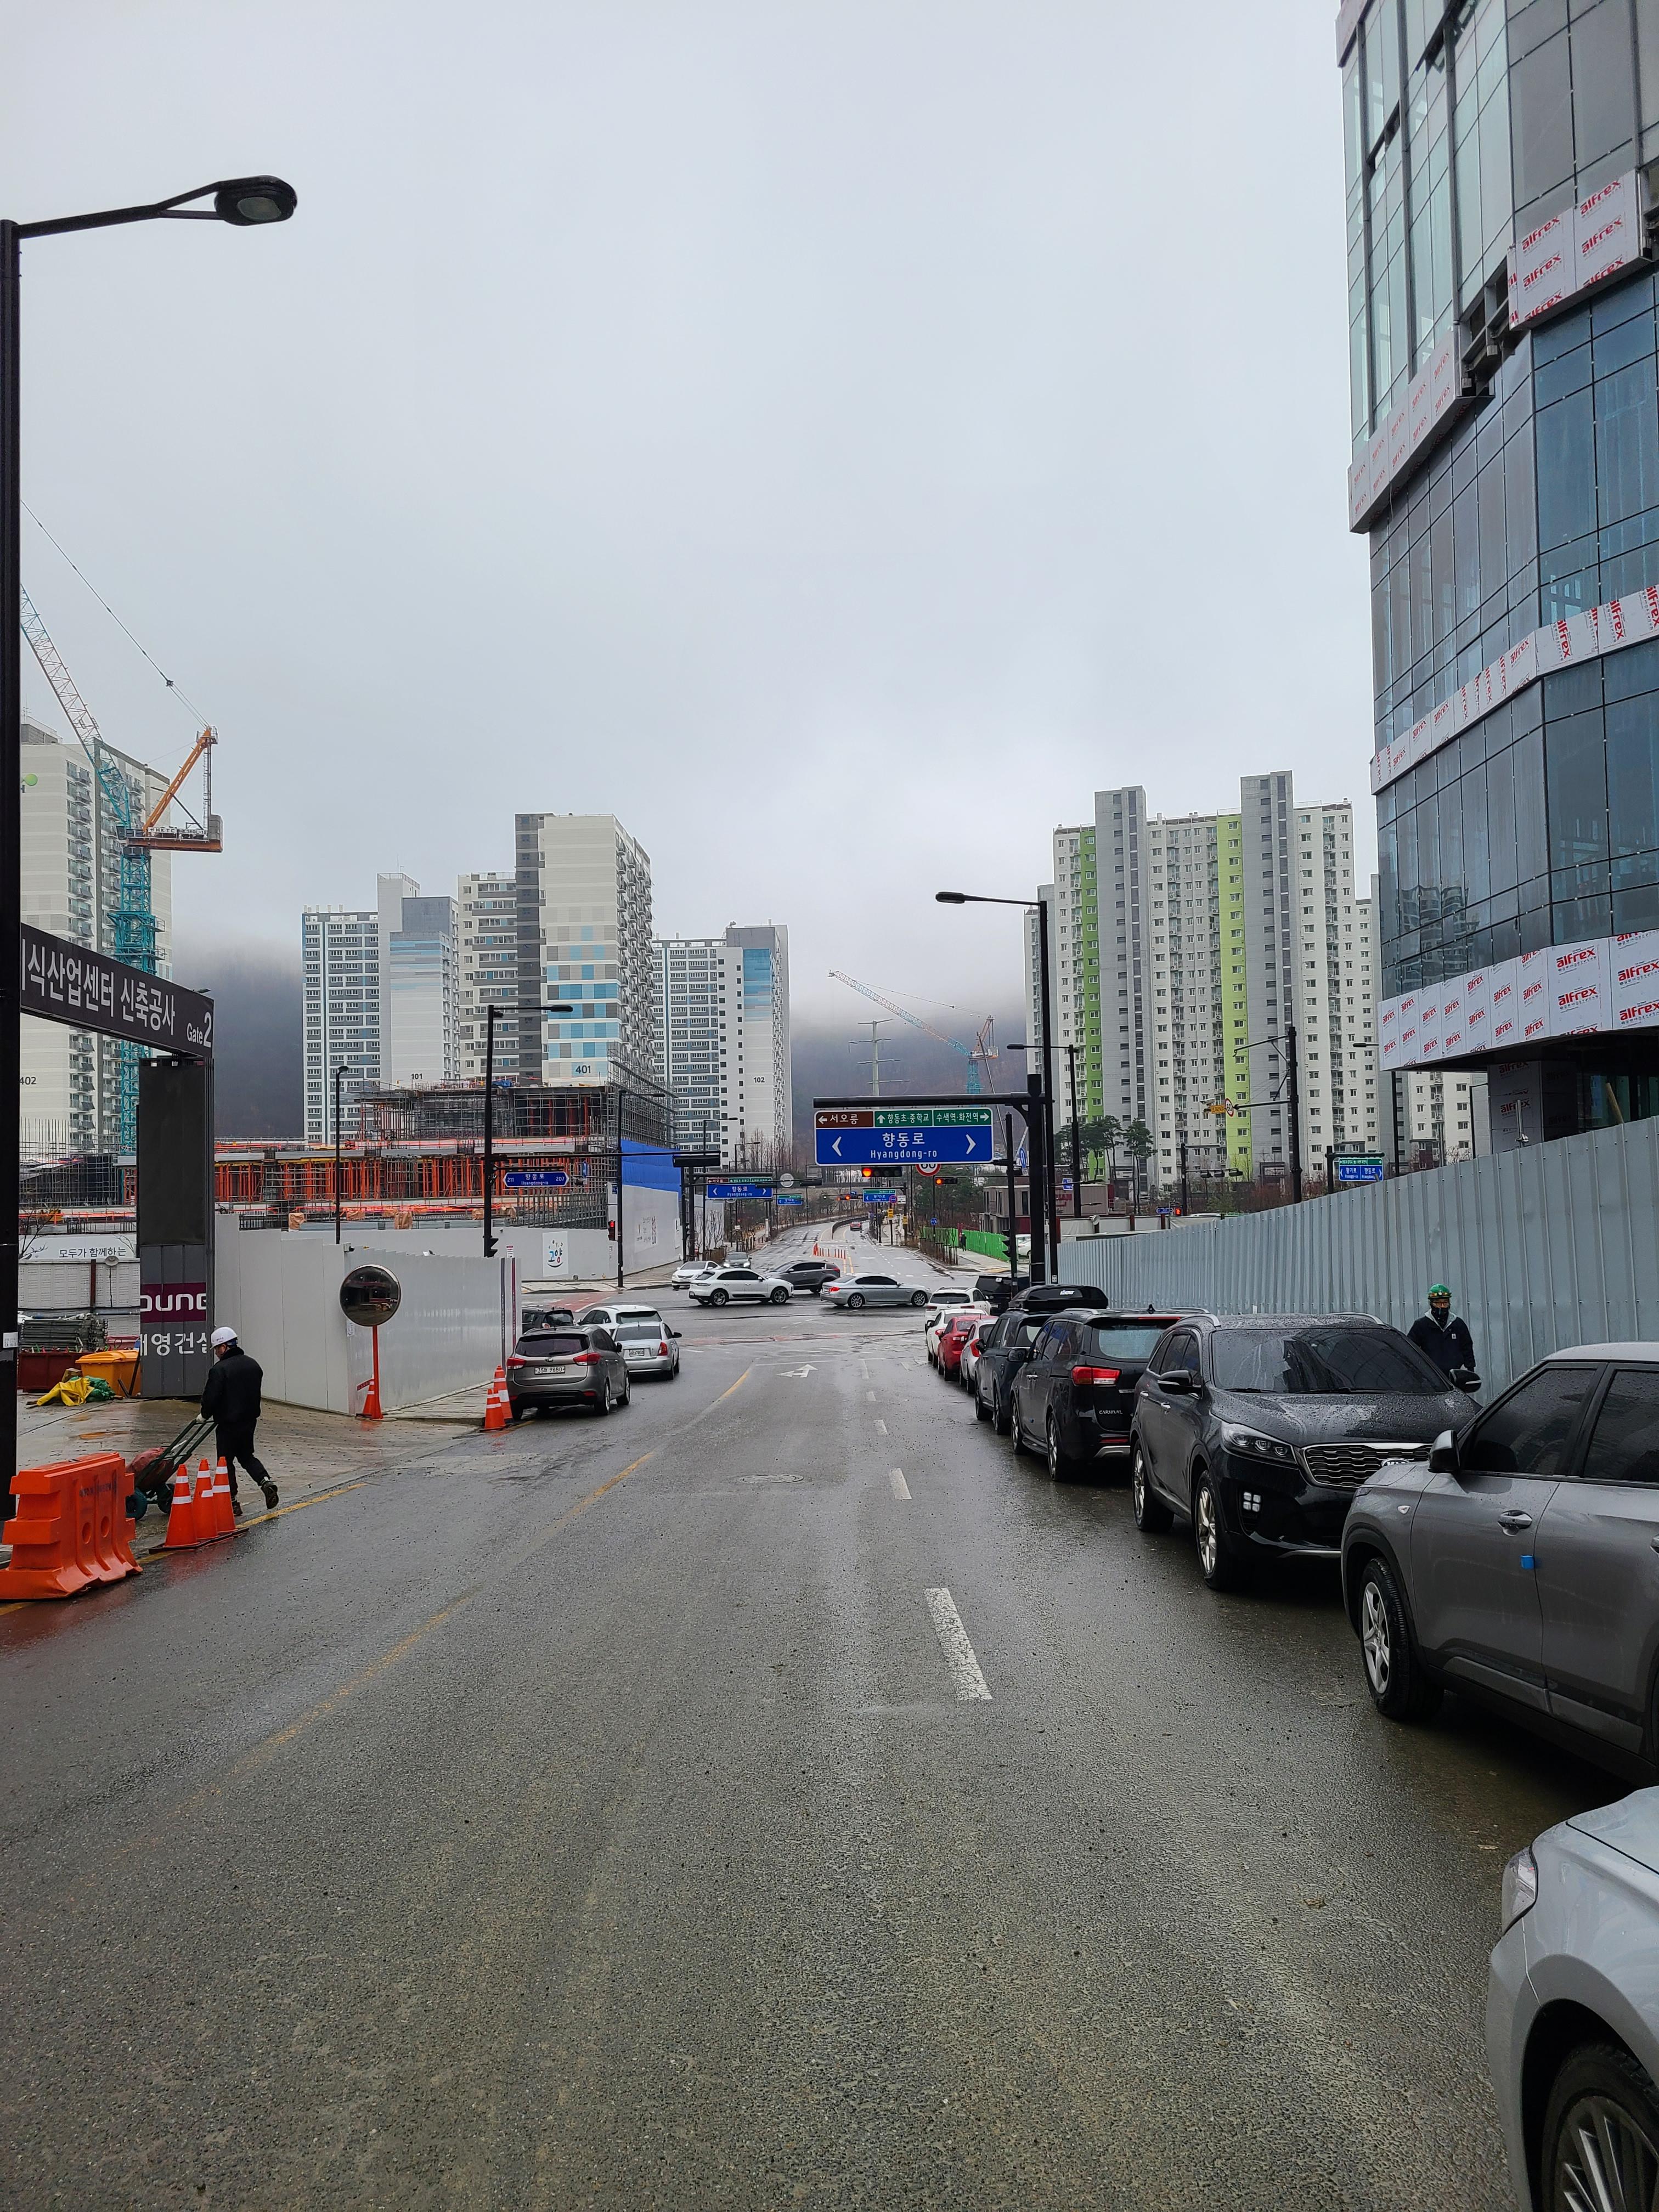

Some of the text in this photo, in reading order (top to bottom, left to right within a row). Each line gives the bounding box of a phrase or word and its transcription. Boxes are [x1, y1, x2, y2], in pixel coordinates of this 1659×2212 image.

[1580, 181, 1621, 215] alfrex
[1522, 217, 1560, 250] alfrex
[1582, 215, 1622, 253] alfrex
[1523, 253, 1561, 287] alfrex
[1556, 949, 1595, 968] alfrex
[1618, 962, 1659, 981] alfrex
[1468, 975, 1483, 992] alfrex
[1523, 982, 1542, 1000] alfrex
[1494, 985, 1511, 1002] alfrex
[1558, 987, 1598, 1006] alfrex
[121, 978, 176, 1035] 신축공사
[1401, 997, 1414, 1012] alfrex
[1444, 1000, 1459, 1015] alfrex
[1620, 1003, 1659, 1021] alfrex
[1383, 1011, 1395, 1025] alfrex
[1423, 1007, 1437, 1022] alfrex
[1469, 1009, 1486, 1025] alfrex
[1402, 1028, 1415, 1042] alfrex
[1495, 1021, 1513, 1037] alfrex
[1525, 1019, 1544, 1037] alfrex
[1384, 1040, 1396, 1053] alfrex
[1424, 1038, 1438, 1053] alfrex
[1446, 1032, 1461, 1048] alfrex
[575, 1065, 591, 1074] 401
[20, 1076, 37, 1085] 402
[830, 1114, 859, 1125] 서오릉
[882, 1132, 926, 1148] 향동로
[871, 1149, 937, 1160] Hyangdong-ro
[59, 1247, 127, 1258] 모두가 함께하는
[548, 1248, 563, 1263] 고양
